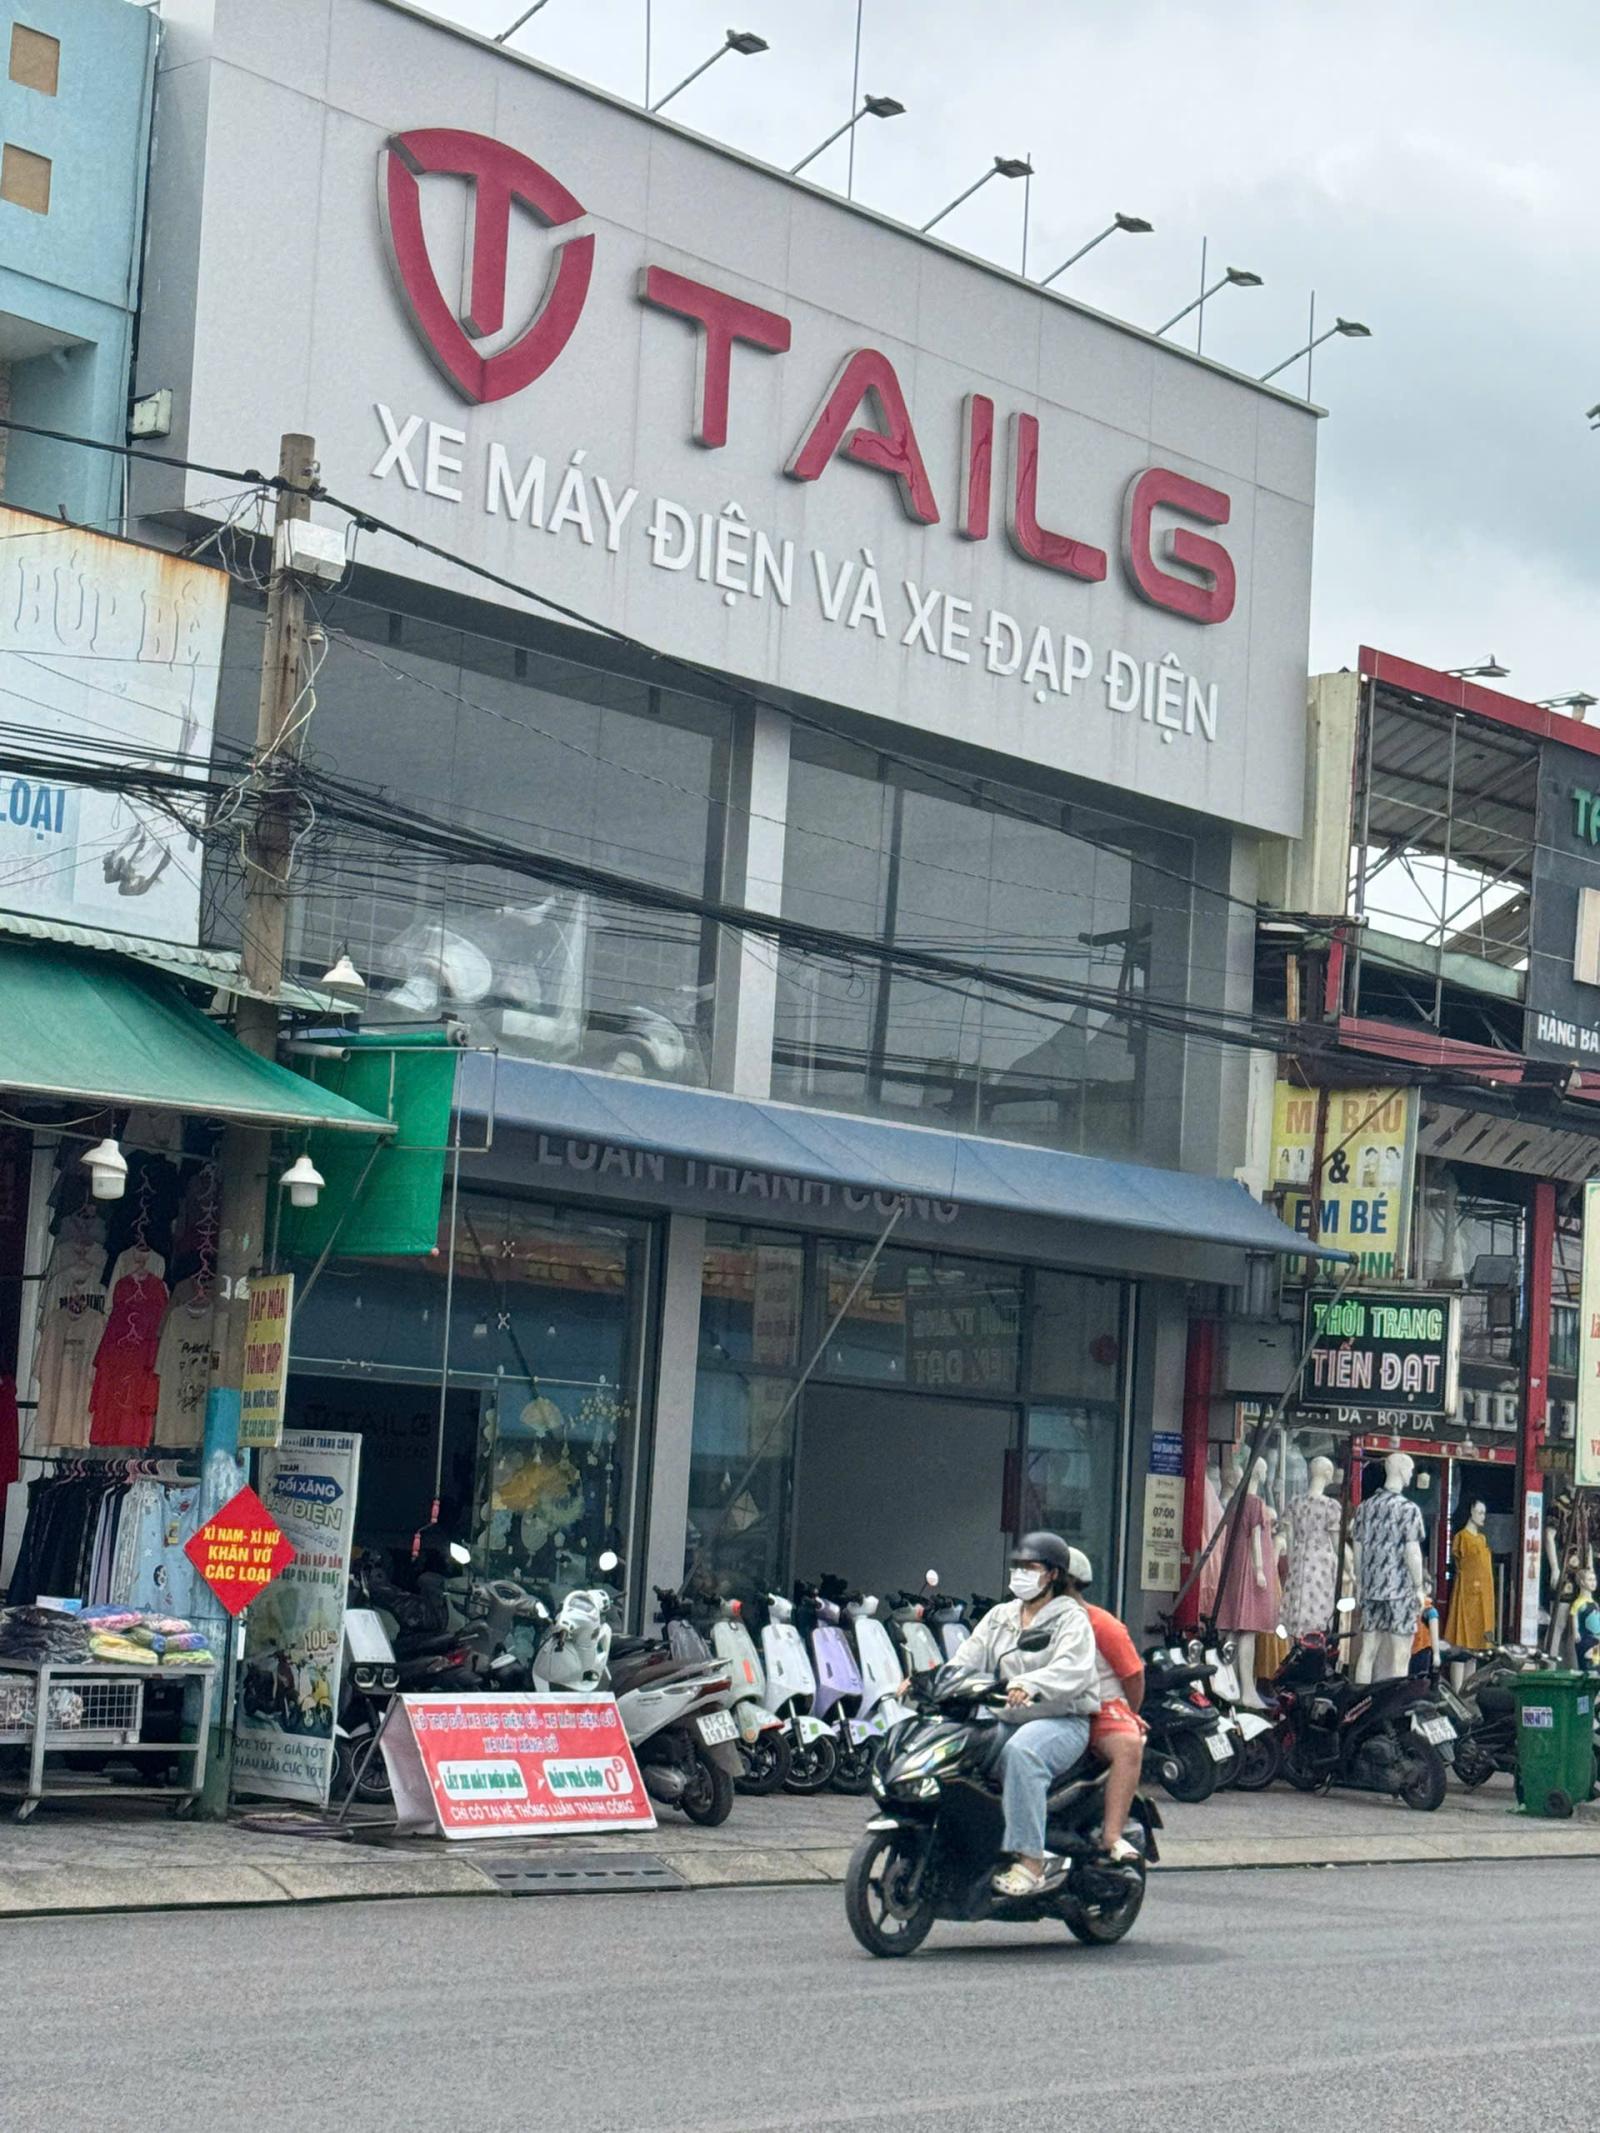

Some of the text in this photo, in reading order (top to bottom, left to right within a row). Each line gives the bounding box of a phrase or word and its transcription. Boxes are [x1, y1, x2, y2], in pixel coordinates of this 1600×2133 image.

[637, 264, 1237, 625] TAILG
[370, 402, 1219, 745] XE MÁY ĐIỆN VÀ XE ĐẠP ĐIỆN
[1537, 1009, 1576, 1049] HÀNG
[1328, 1150, 1351, 1184] &
[1295, 1191, 1389, 1234] EM BÉ
[1313, 1300, 1443, 1342] THỜI TRANG
[1311, 1338, 1441, 1402] TIẾN ĐẠT
[203, 1524, 216, 1541] XÌ
[250, 1527, 261, 1545] XÌ
[208, 1543, 273, 1563] KHĂN VỚ
[204, 1562, 272, 1585] CÁC LOẠI
